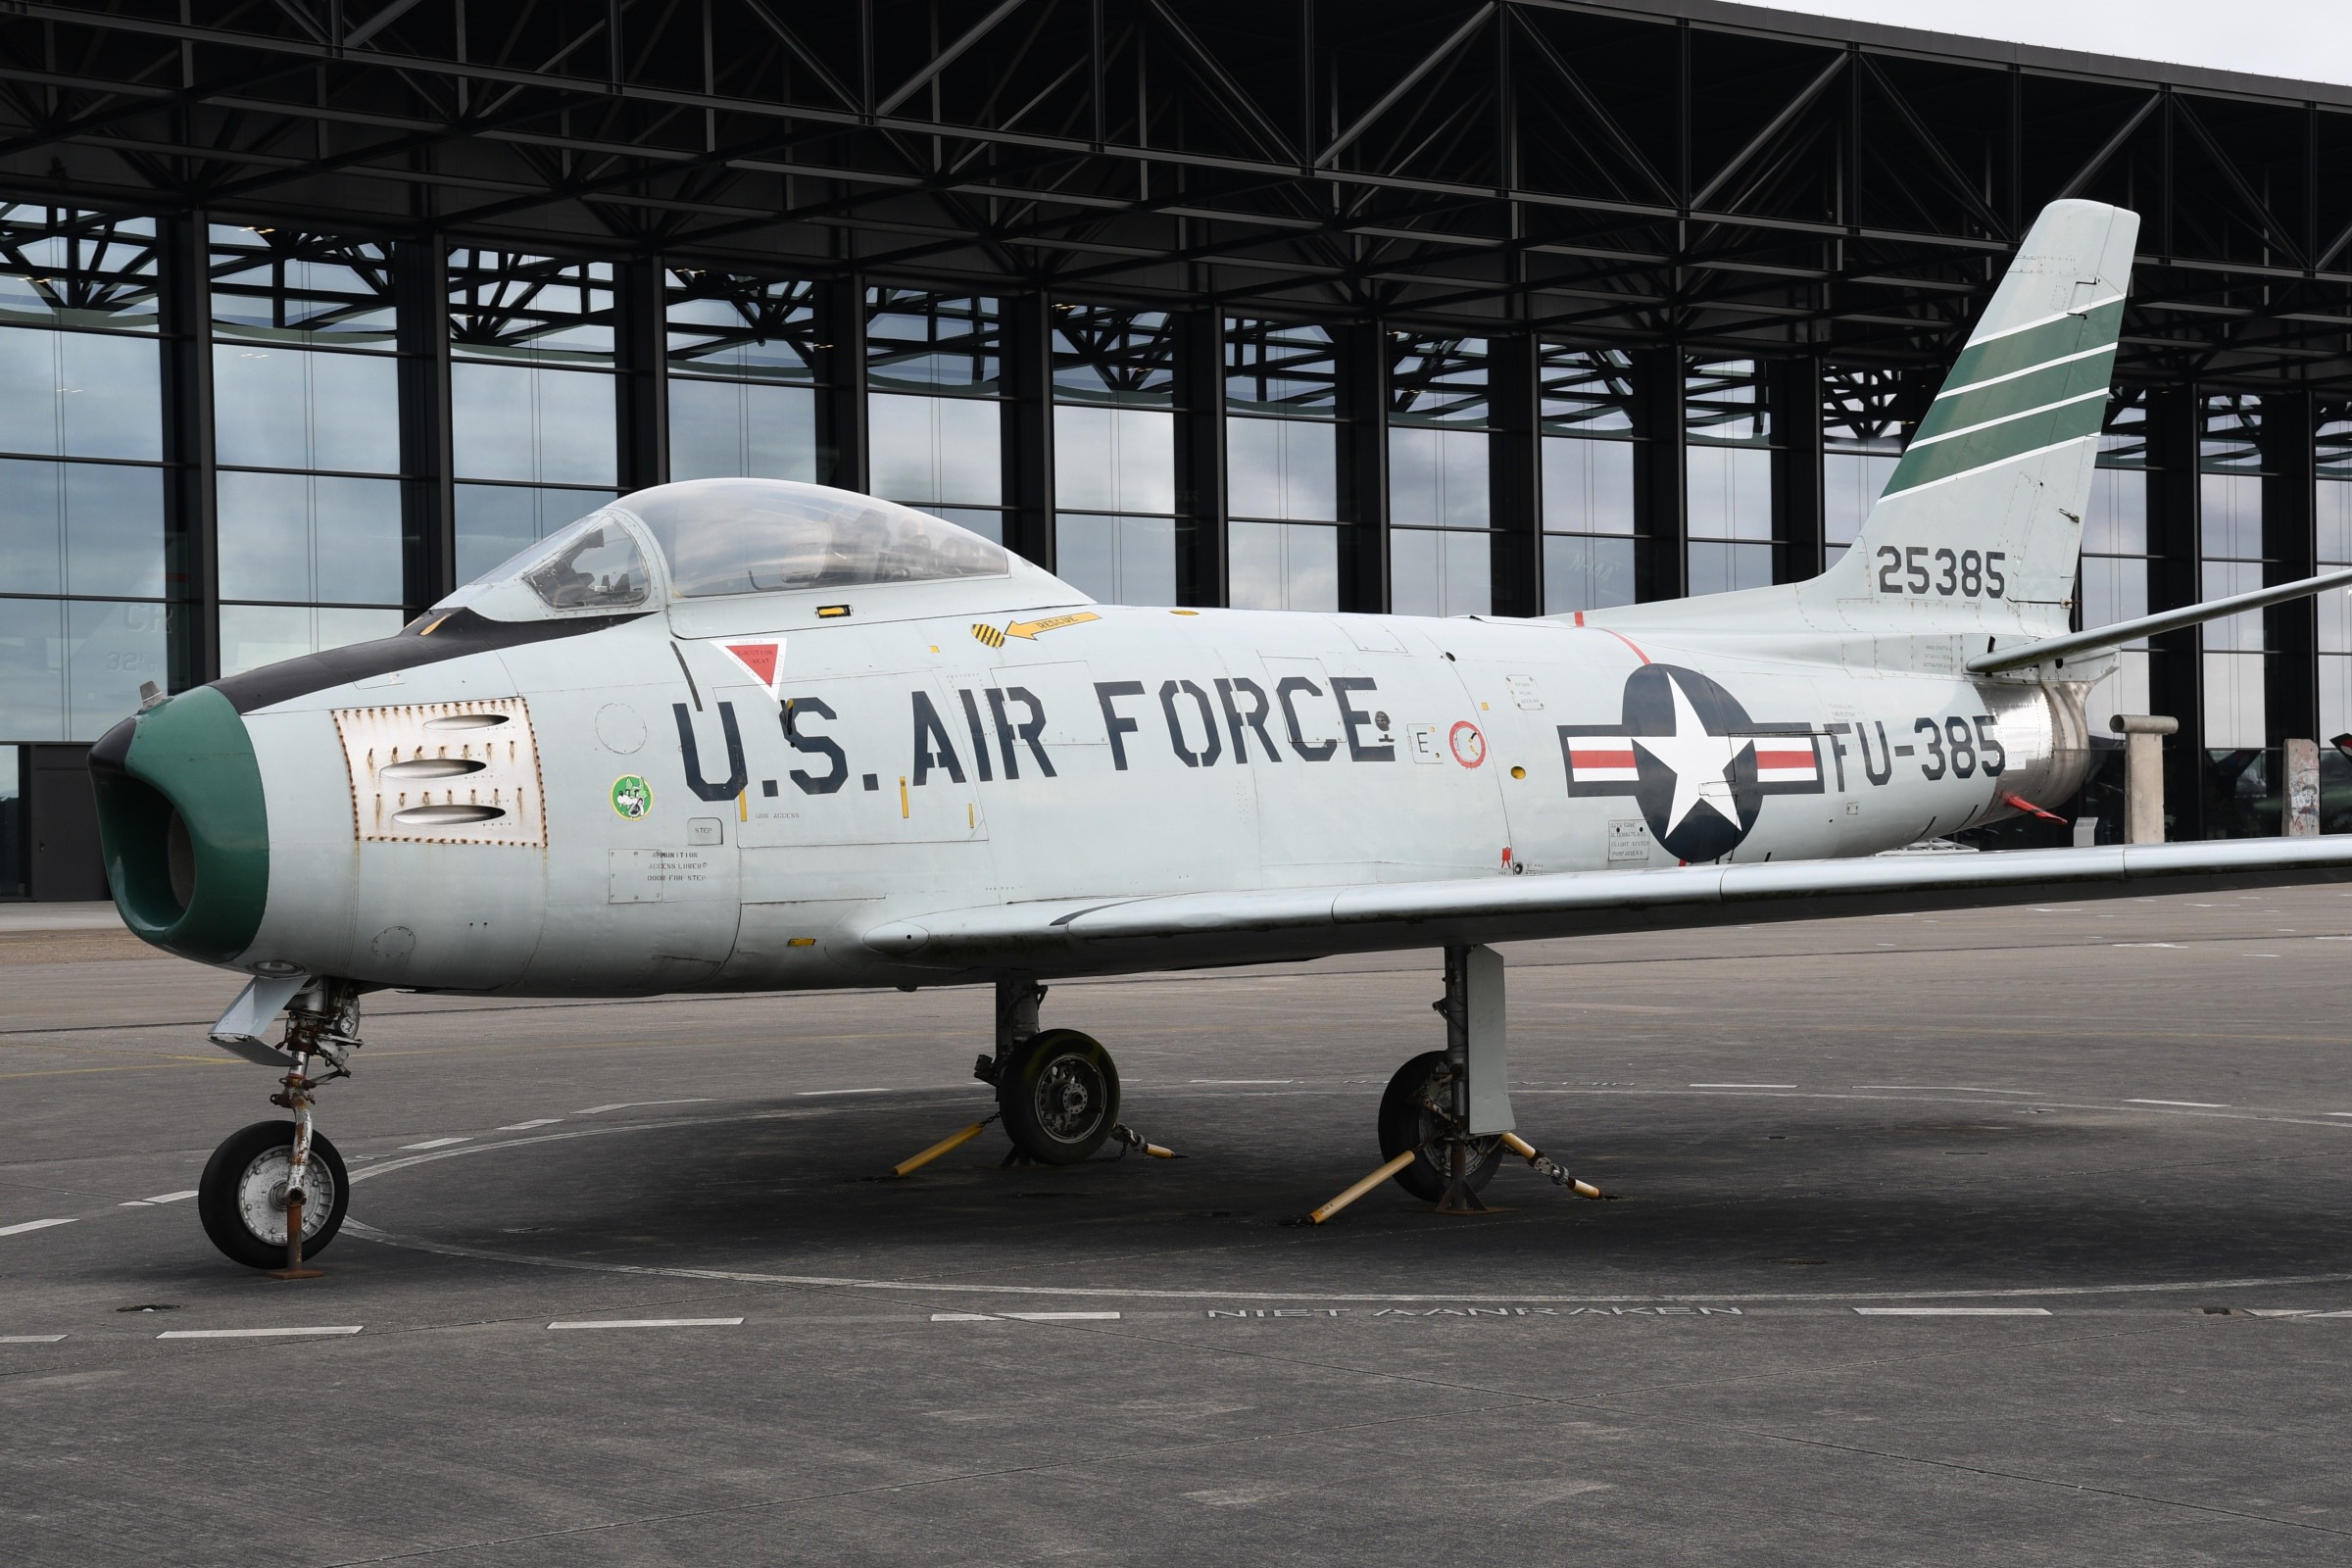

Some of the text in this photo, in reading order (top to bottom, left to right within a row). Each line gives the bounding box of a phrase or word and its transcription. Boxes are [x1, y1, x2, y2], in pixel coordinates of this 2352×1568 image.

[1877, 545, 2006, 599] 25385
[1036, 615, 1078, 629] RESCUE
[672, 676, 1396, 802] U.S. AIR FORCE
[1416, 732, 1429, 753] E
[1823, 714, 2006, 793] FU-385
[1207, 1306, 1743, 1318] NIET AANRAKEN
